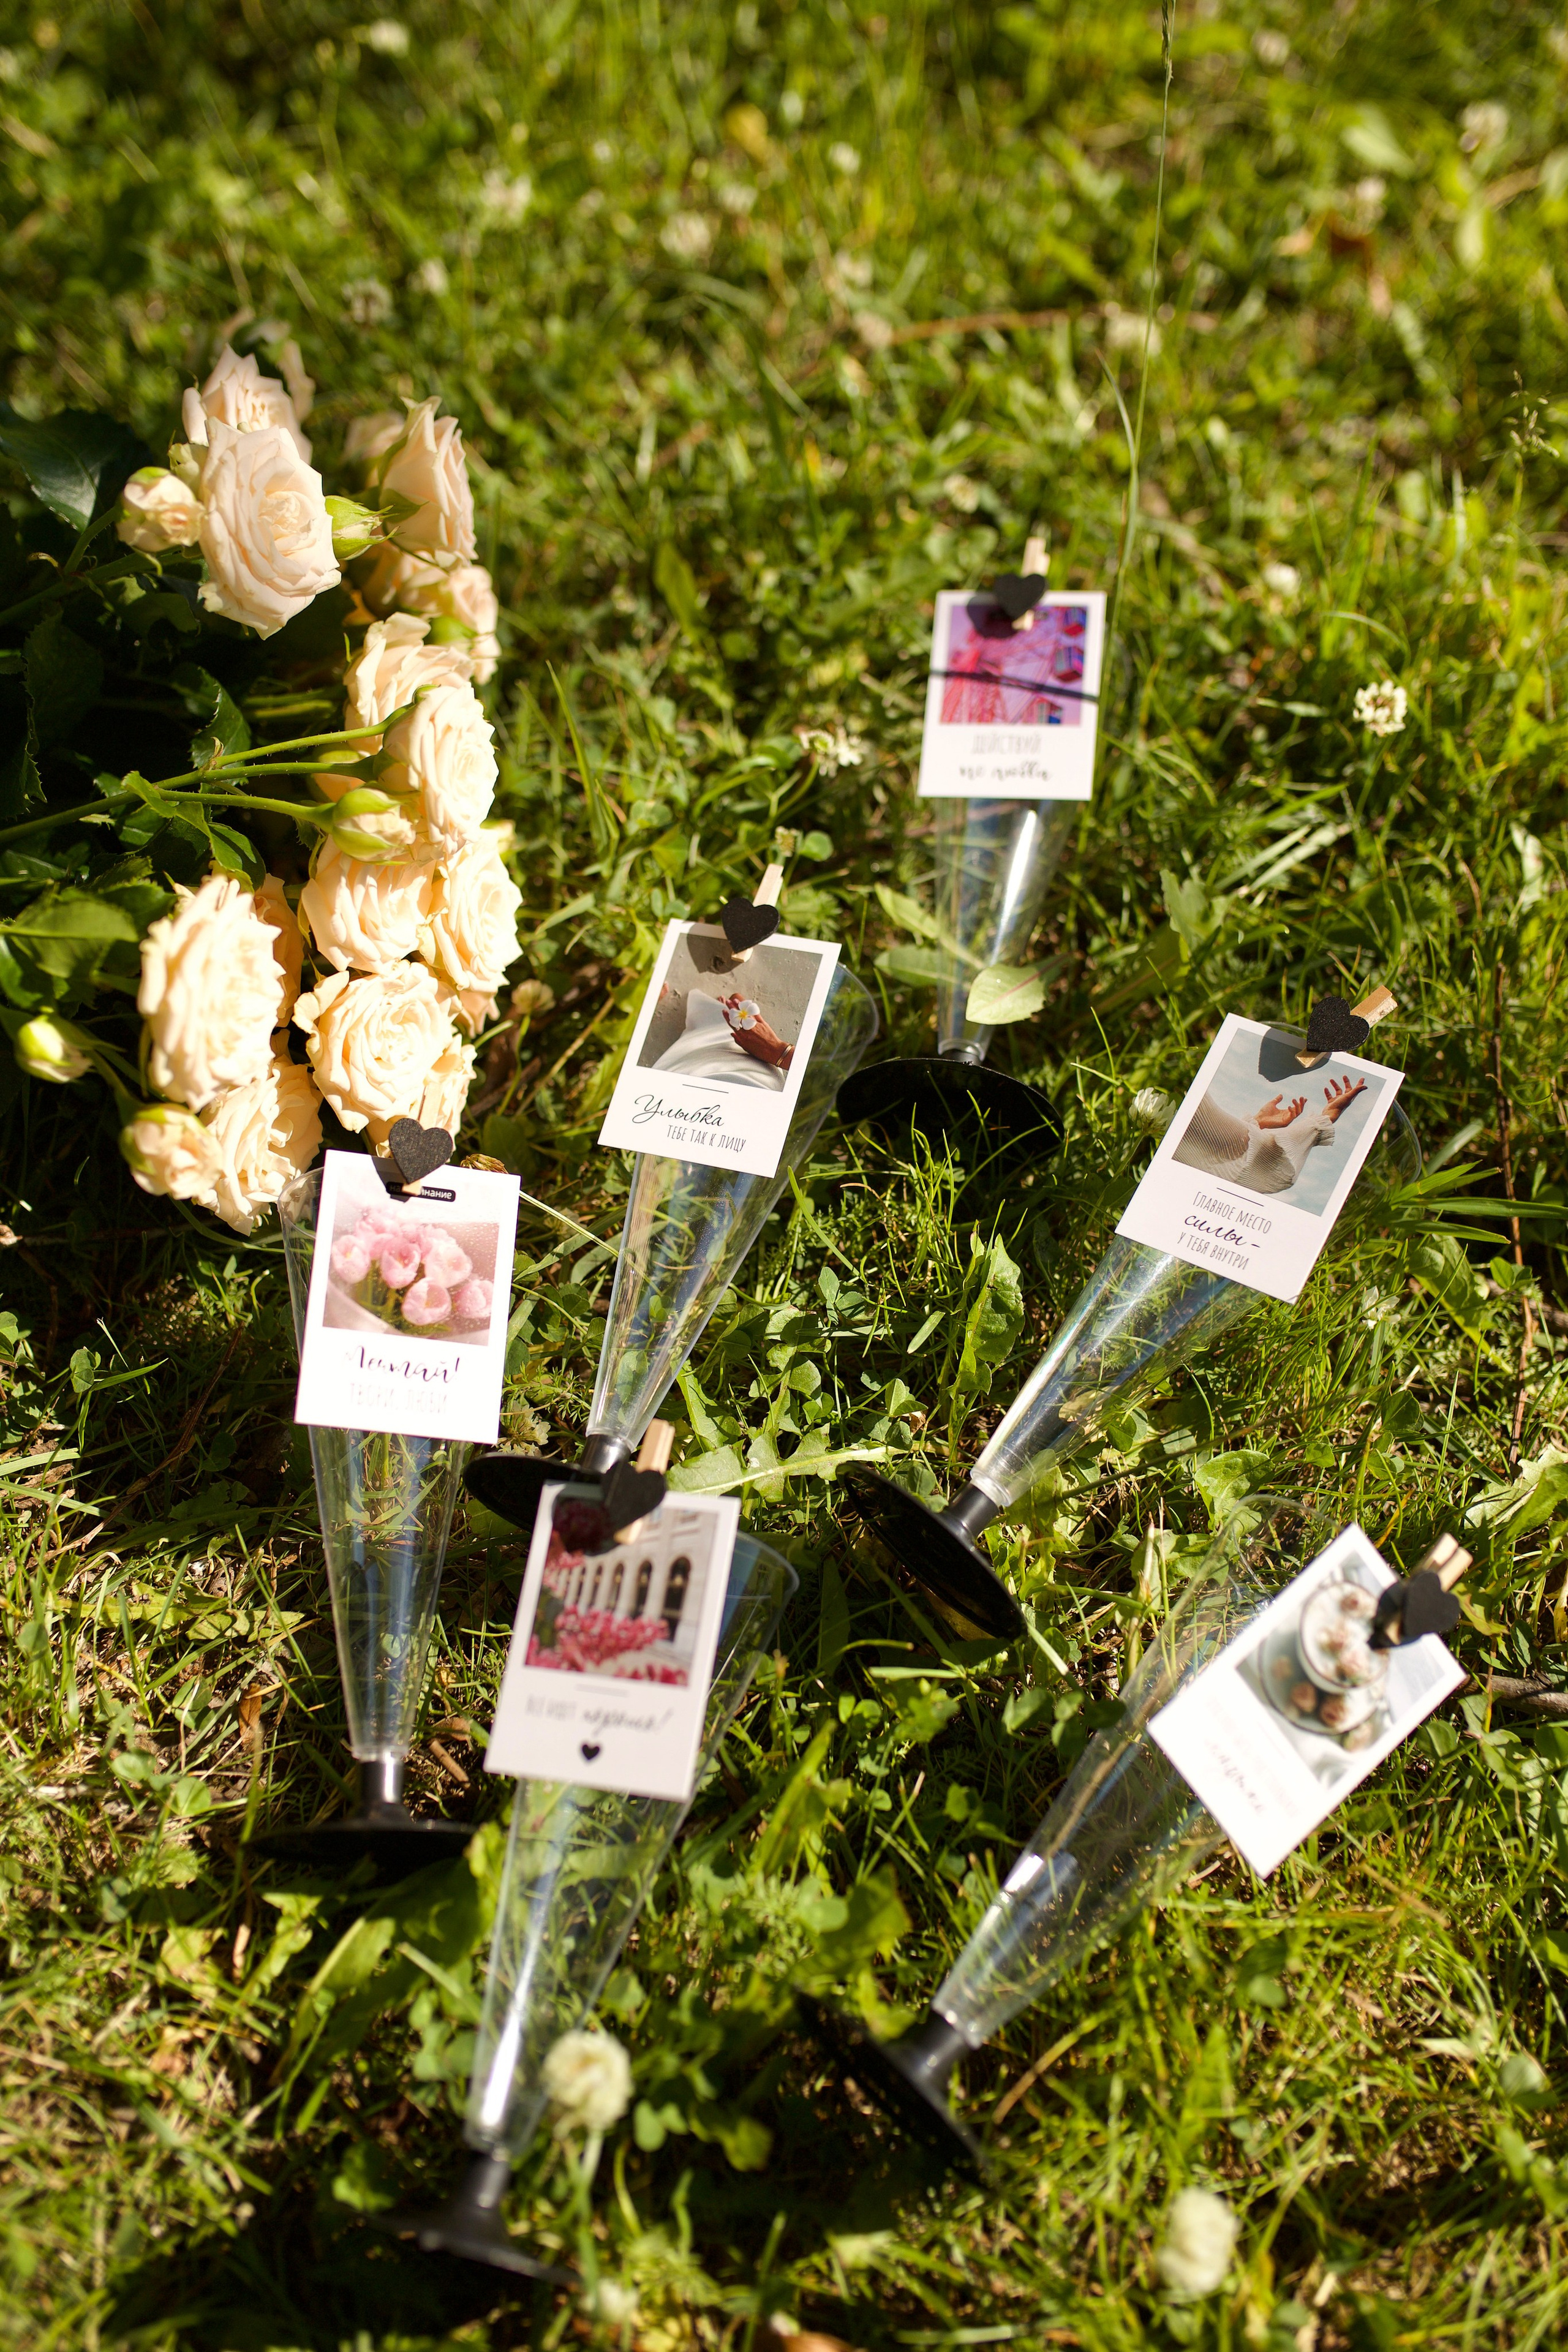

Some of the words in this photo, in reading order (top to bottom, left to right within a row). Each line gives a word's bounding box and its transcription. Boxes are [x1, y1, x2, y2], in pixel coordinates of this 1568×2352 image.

[631, 1094, 725, 1127] Улыбка
[667, 1124, 688, 1142] ТЕБЕ
[690, 1129, 708, 1145] ТАК
[709, 1133, 717, 1147] К
[717, 1134, 747, 1153] ЛИЦУ
[1193, 1191, 1236, 1221] ГЛАВНОЕ
[1235, 1210, 1272, 1234] МЕСТО
[1184, 1215, 1247, 1246] силы
[1177, 1231, 1184, 1245] У
[1186, 1234, 1210, 1255] ТЕБЯ
[1210, 1244, 1250, 1270] ВНУТРИ
